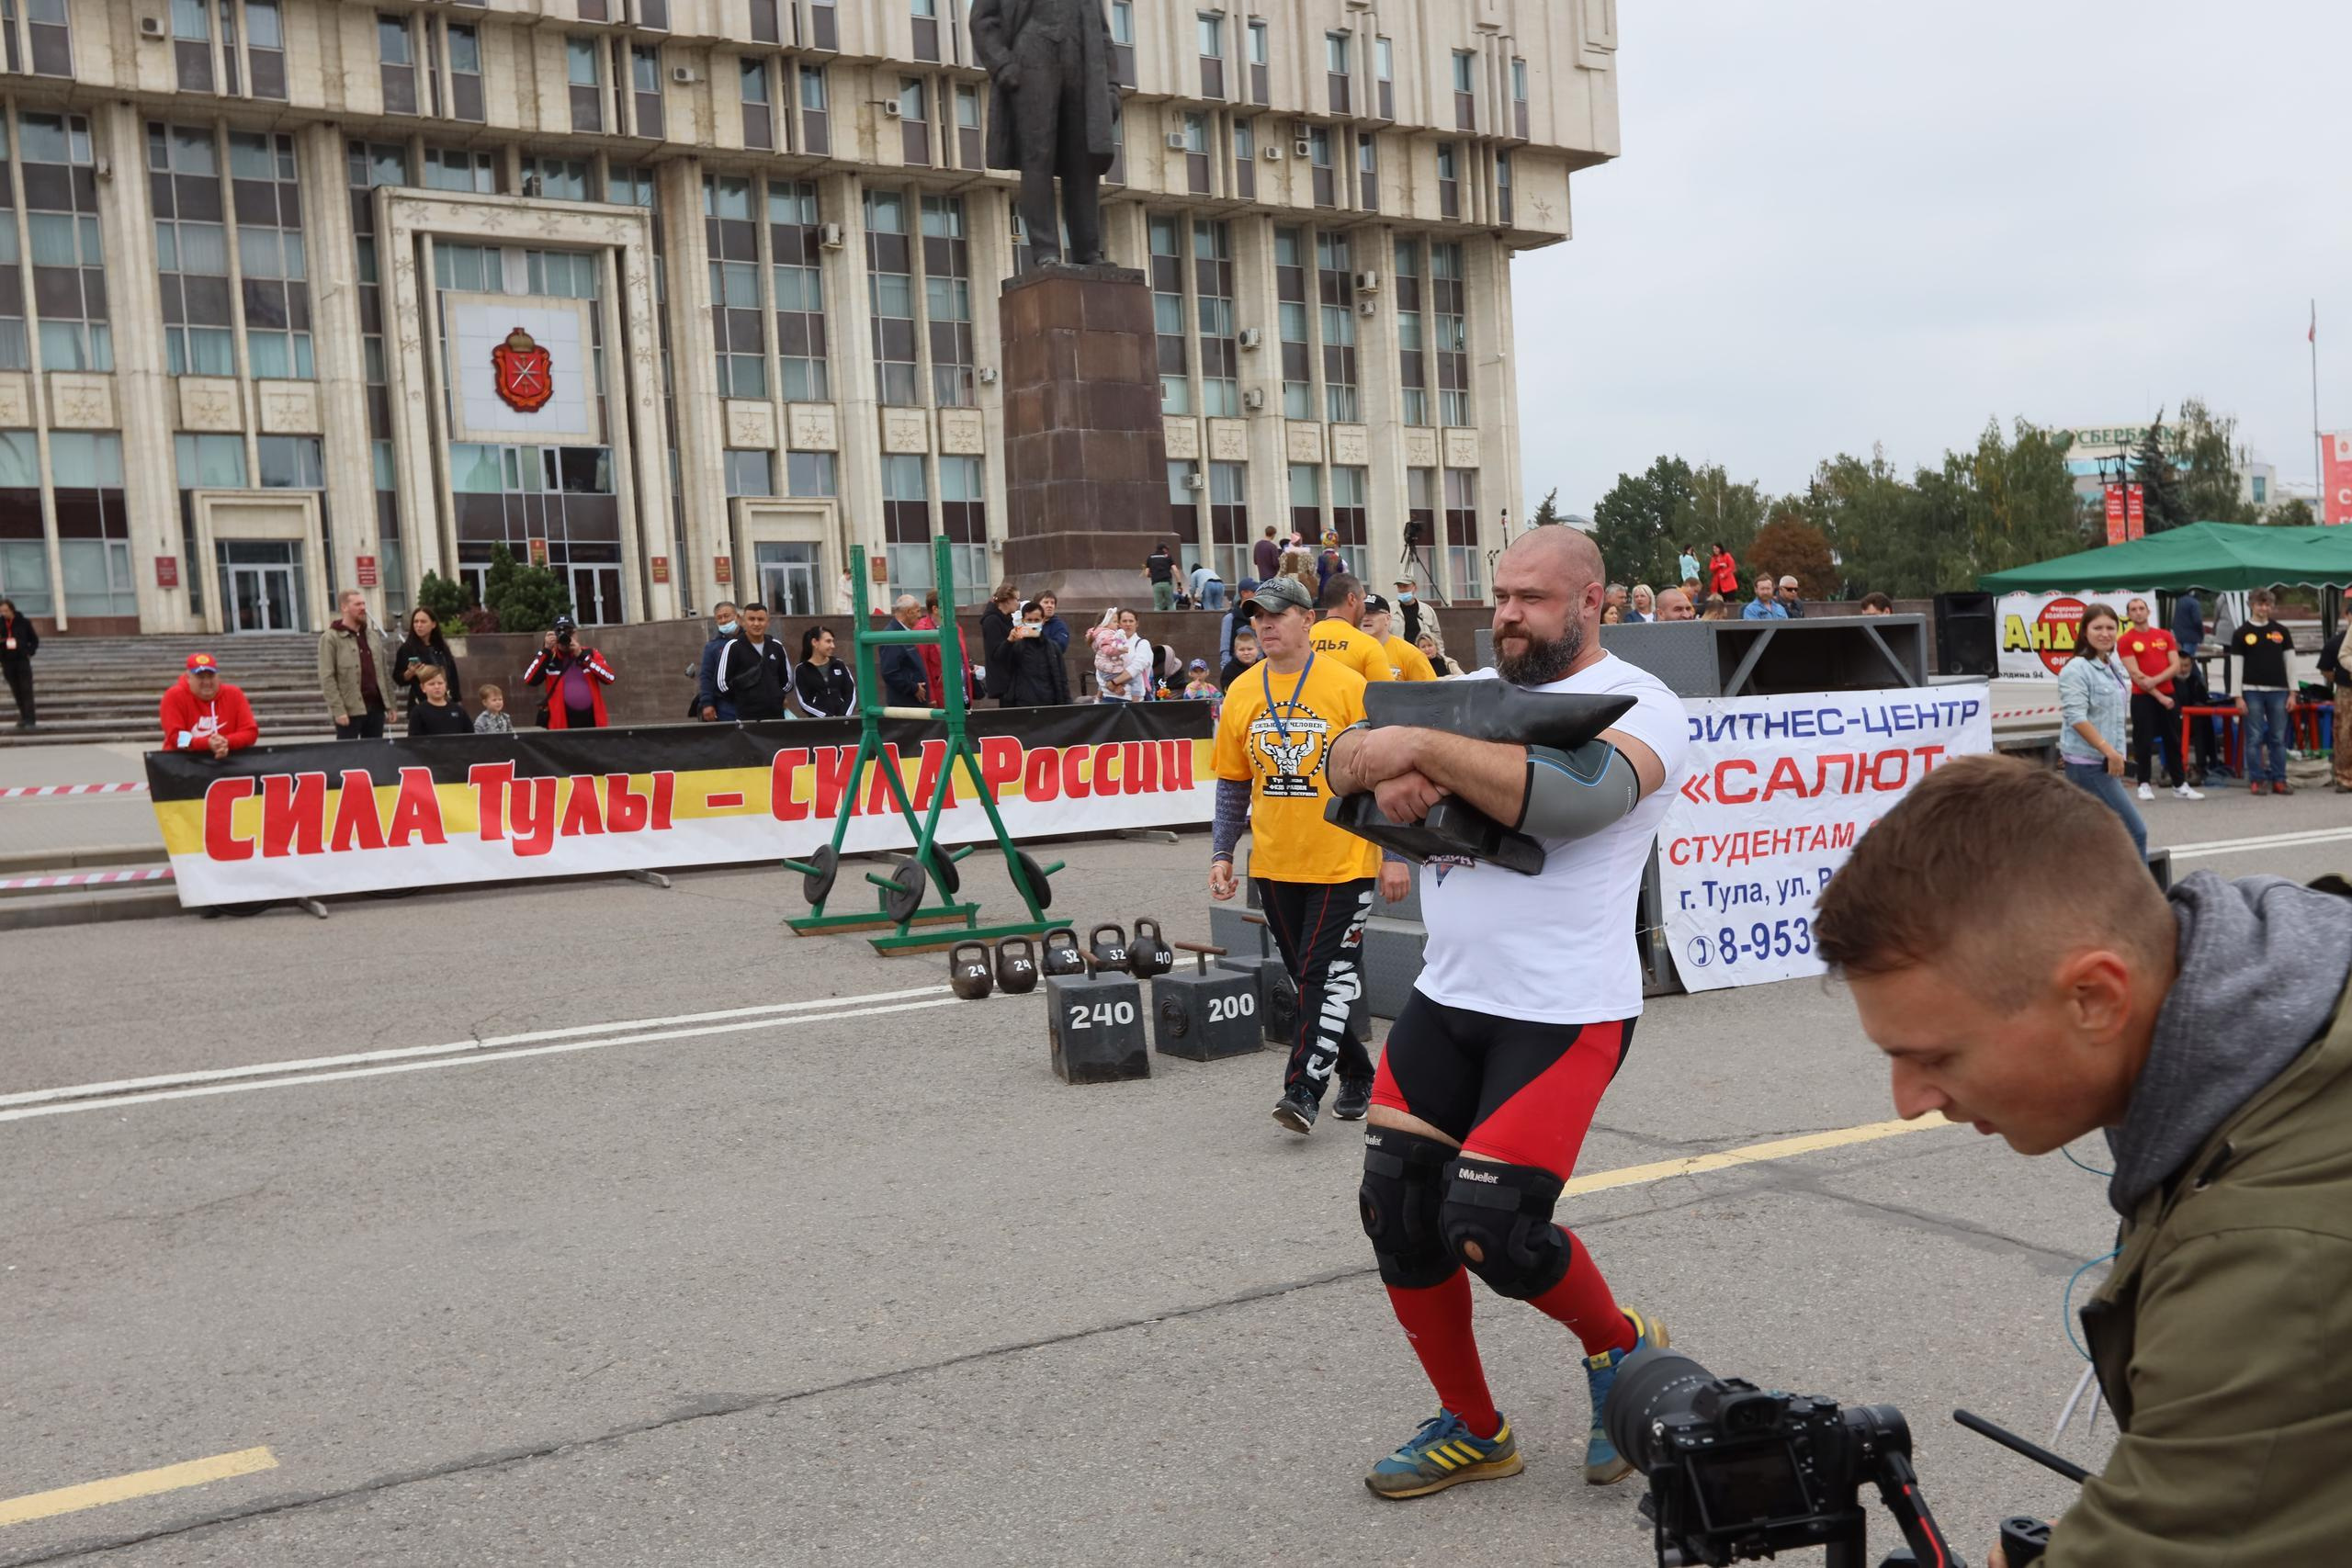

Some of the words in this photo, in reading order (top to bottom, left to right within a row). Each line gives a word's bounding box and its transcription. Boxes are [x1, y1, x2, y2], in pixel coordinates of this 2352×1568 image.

[1309, 639, 1349, 652] УДЬЯ
[2033, 671, 2044, 679] 94
[1680, 744, 1966, 806] «САЛЮТ
[204, 765, 449, 862] СИЛА
[771, 739, 958, 822] СИЛА
[1668, 821, 1856, 867] СТУДЕНТАМ
[1679, 889, 1697, 910] г.
[1702, 880, 1770, 914] Тула,
[1778, 874, 1812, 906] ул.
[1062, 949, 1080, 964] 32
[1109, 948, 1126, 961] 32
[1155, 951, 1170, 964] 40
[967, 964, 987, 977] 24
[1013, 958, 1032, 972] 24
[1069, 1001, 1135, 1030] 240
[1208, 993, 1255, 1023] 200
[1462, 1168, 1499, 1185] Mueller
